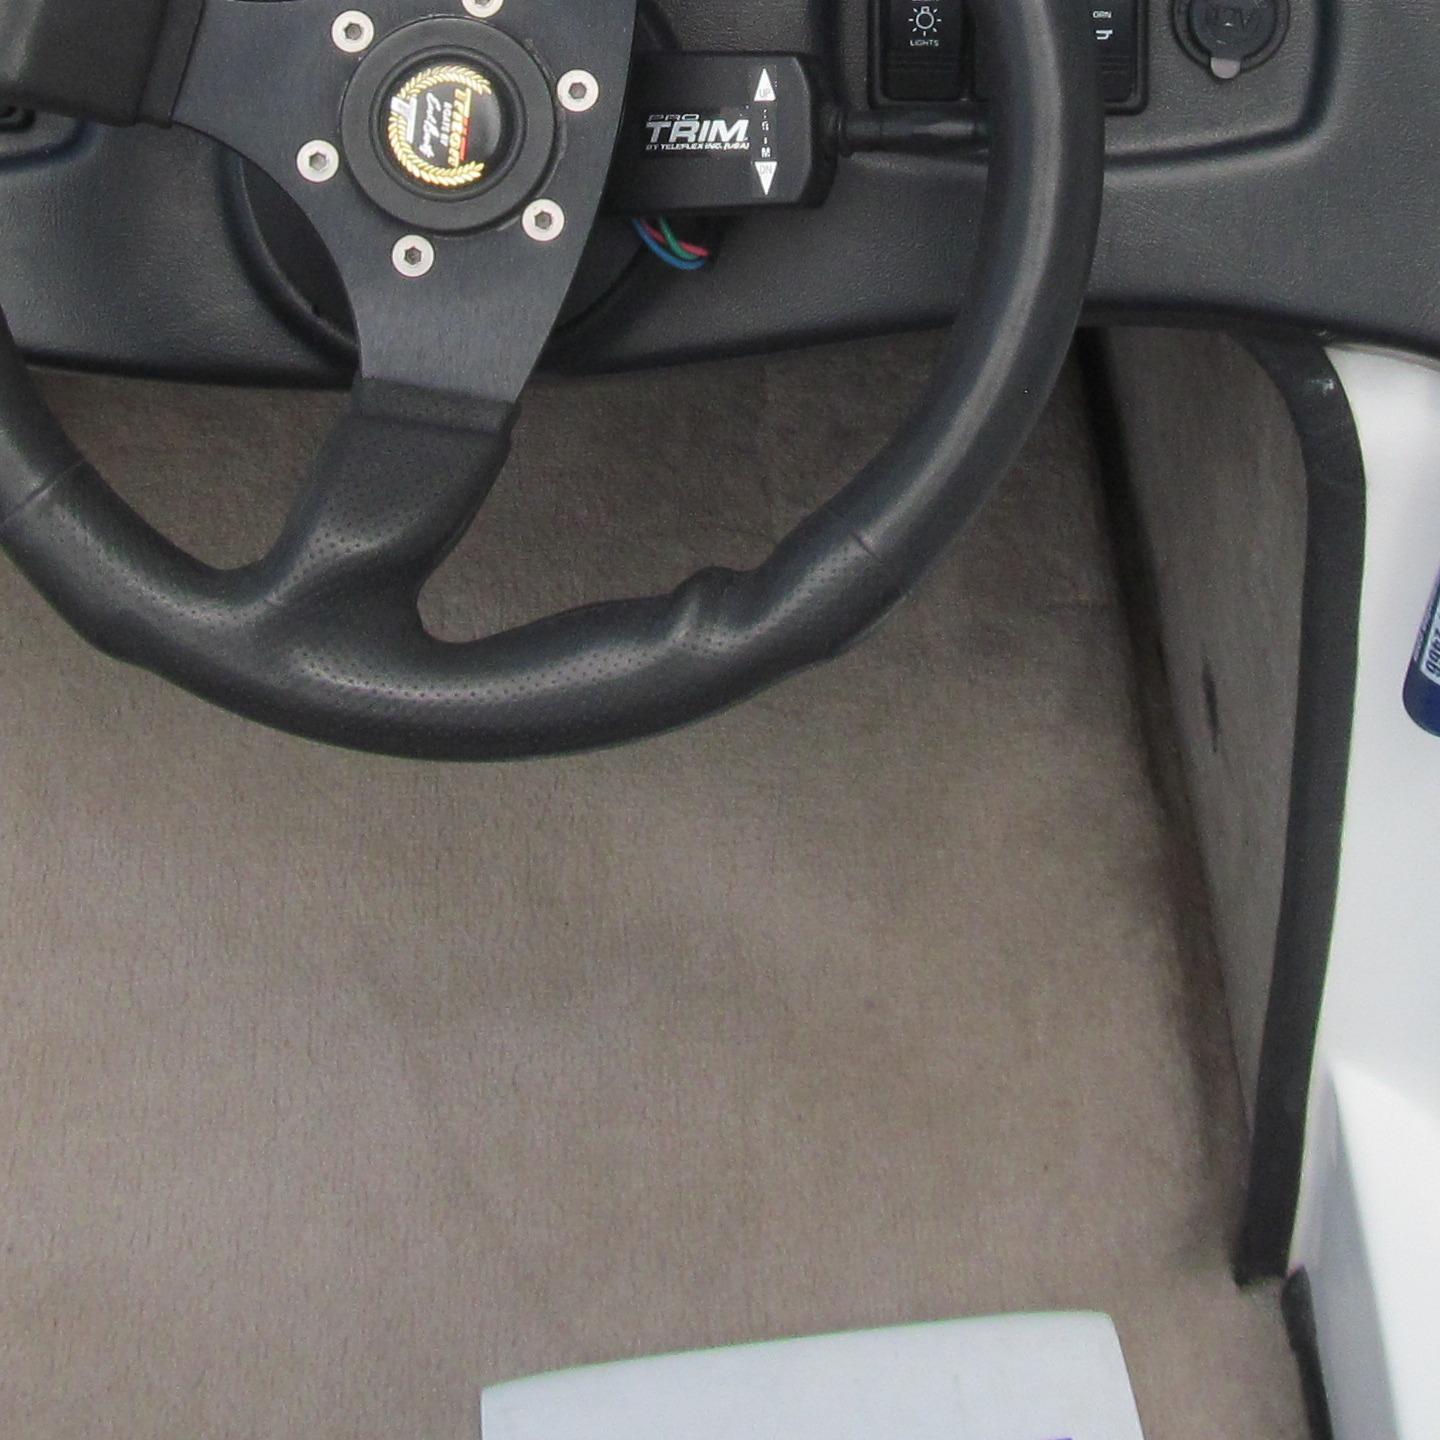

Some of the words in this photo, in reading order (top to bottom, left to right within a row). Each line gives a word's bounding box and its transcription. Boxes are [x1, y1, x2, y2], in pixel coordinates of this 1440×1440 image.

[1092, 10, 1112, 19] ORN
[910, 39, 940, 47] LIGHTS
[759, 88, 771, 99] UP
[648, 113, 700, 121] PRO
[645, 119, 750, 143] TRIM
[760, 164, 773, 175] DN
